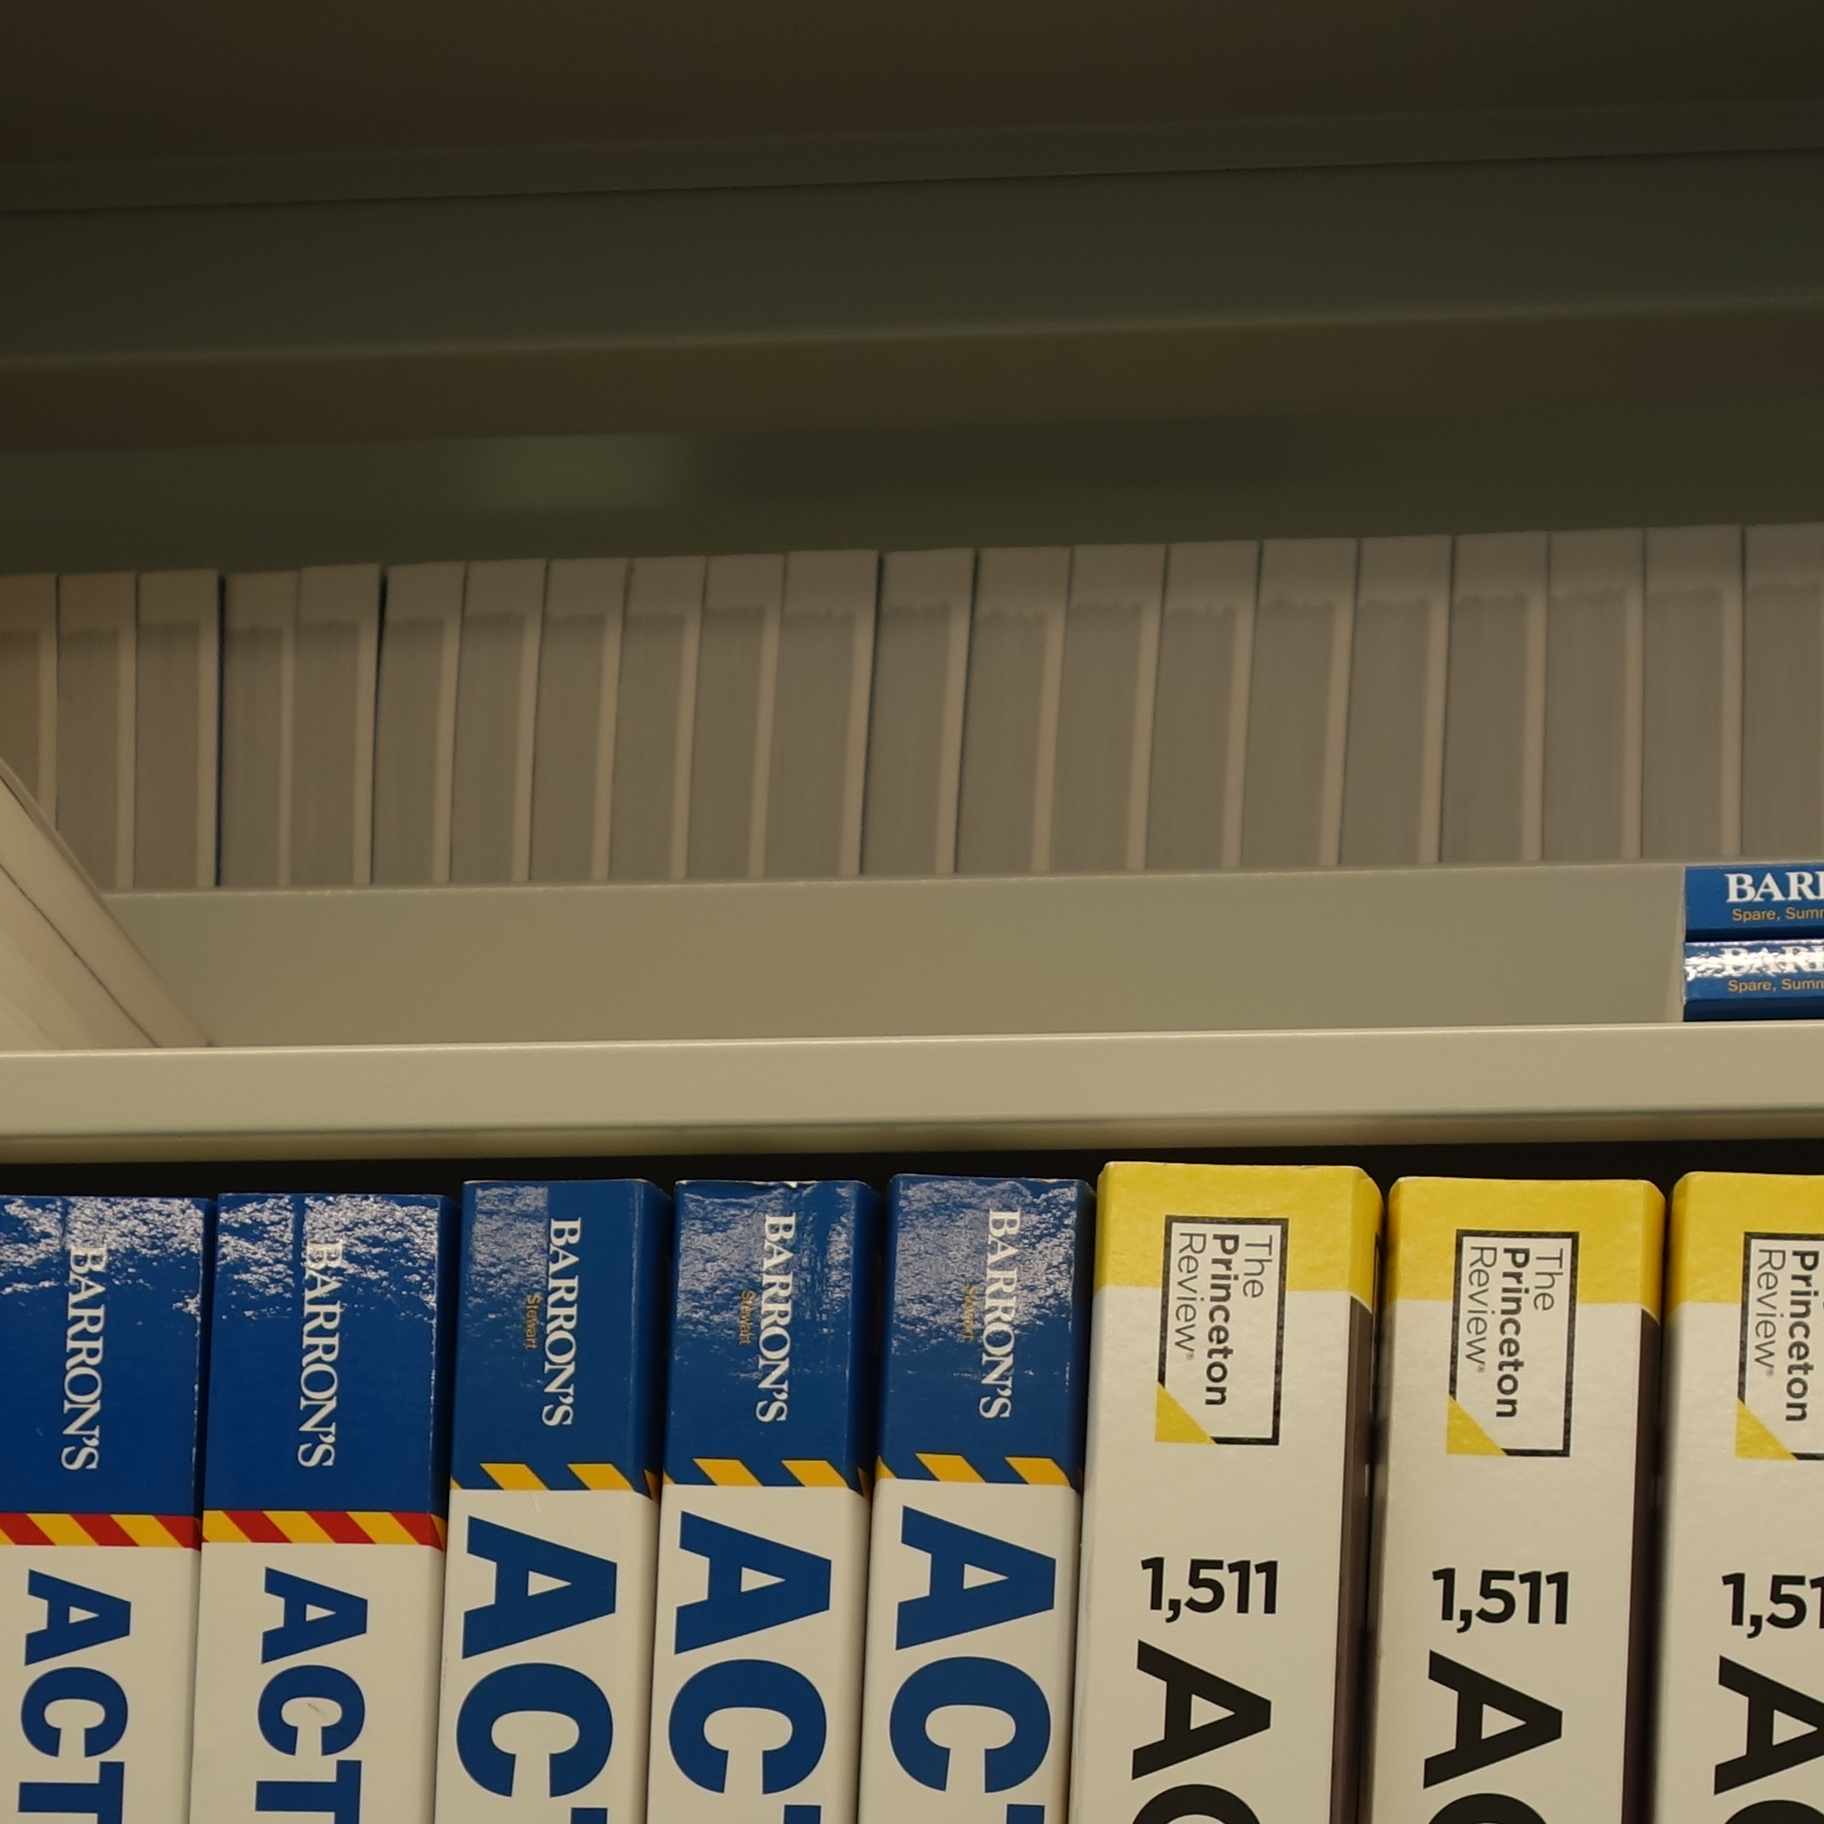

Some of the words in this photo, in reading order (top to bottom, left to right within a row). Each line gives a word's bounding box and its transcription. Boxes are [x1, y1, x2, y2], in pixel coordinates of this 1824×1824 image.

[1731, 907, 1781, 924] Spare,
[1242, 1234, 1273, 1299] The
[541, 1217, 582, 1427] BARRON'S
[1197, 1233, 1240, 1406] Princeton
[1140, 1556, 1278, 1624] 1,511
